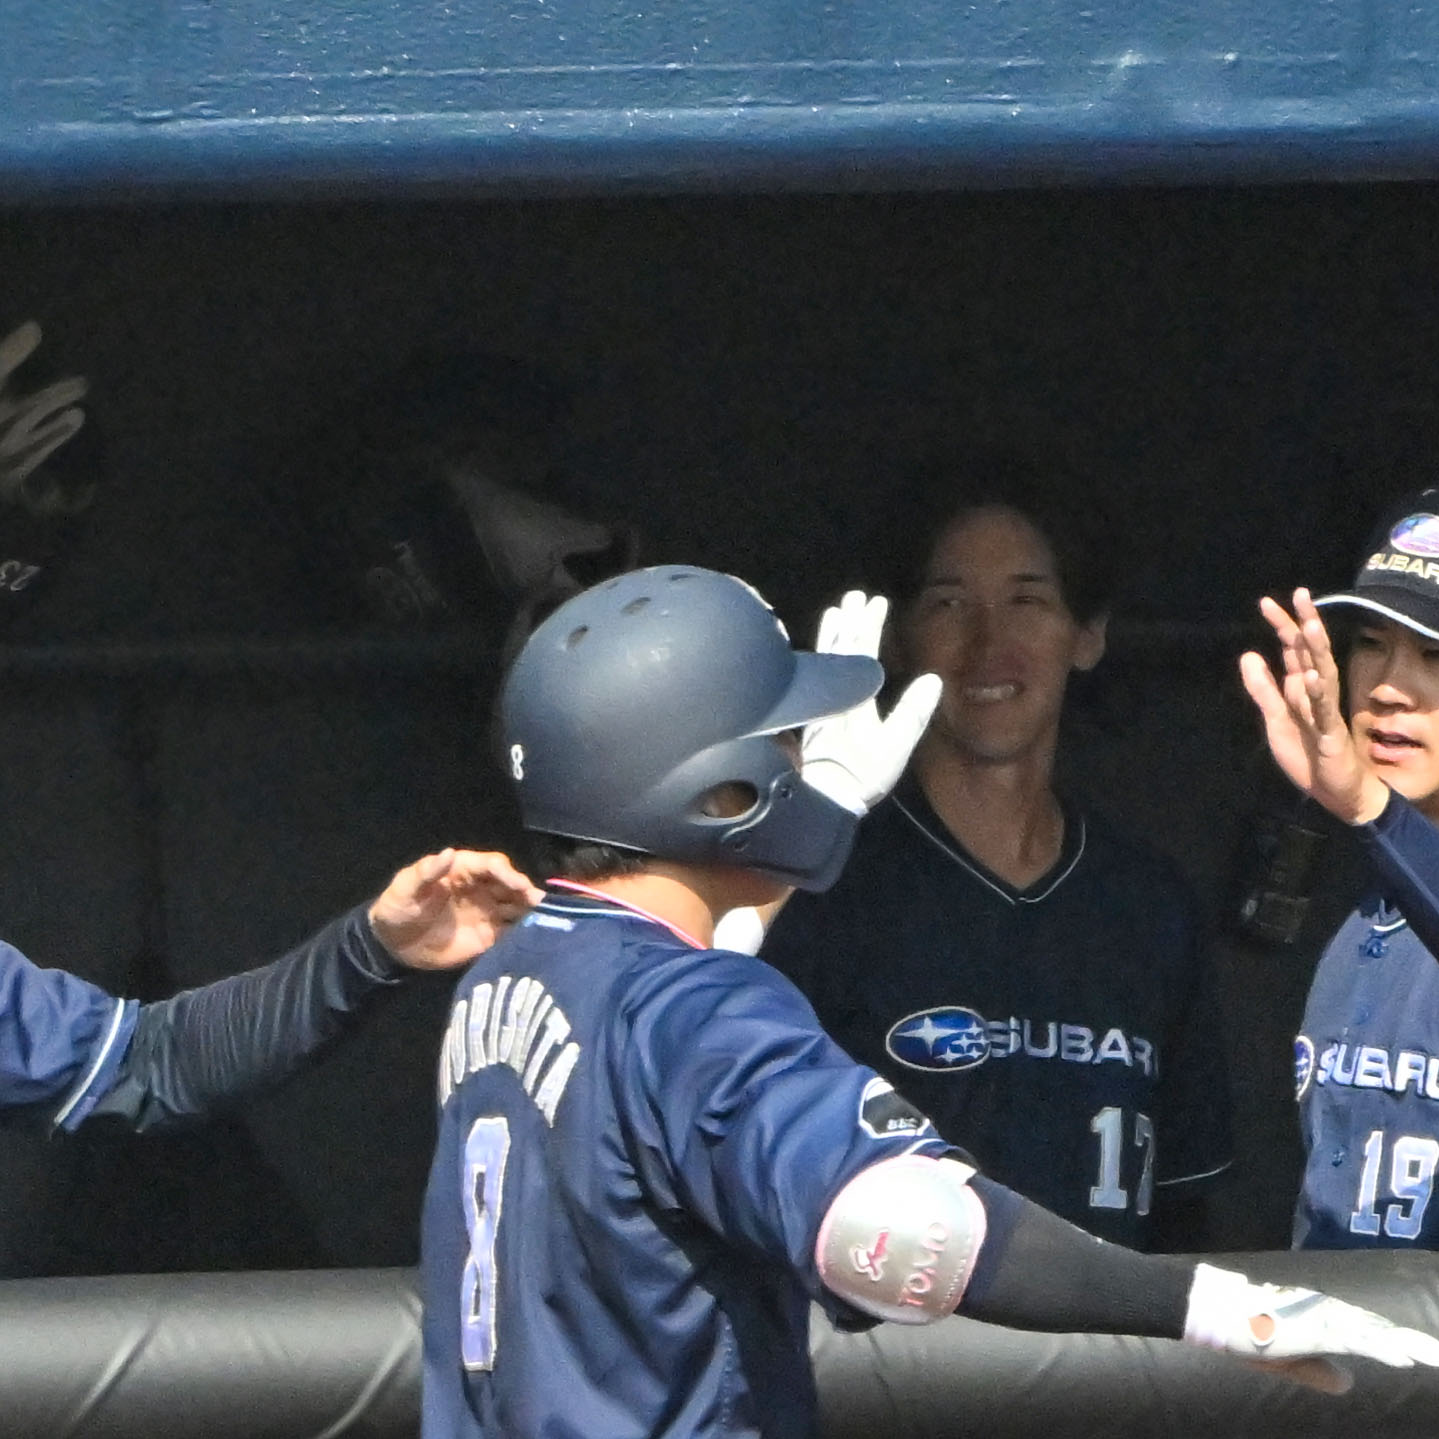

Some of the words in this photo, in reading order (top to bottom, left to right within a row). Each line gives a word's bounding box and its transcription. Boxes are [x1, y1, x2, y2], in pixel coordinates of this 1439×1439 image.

[511, 744, 524, 780] 8
[985, 1016, 1159, 1076] SUBAR
[461, 1116, 511, 1372] 8
